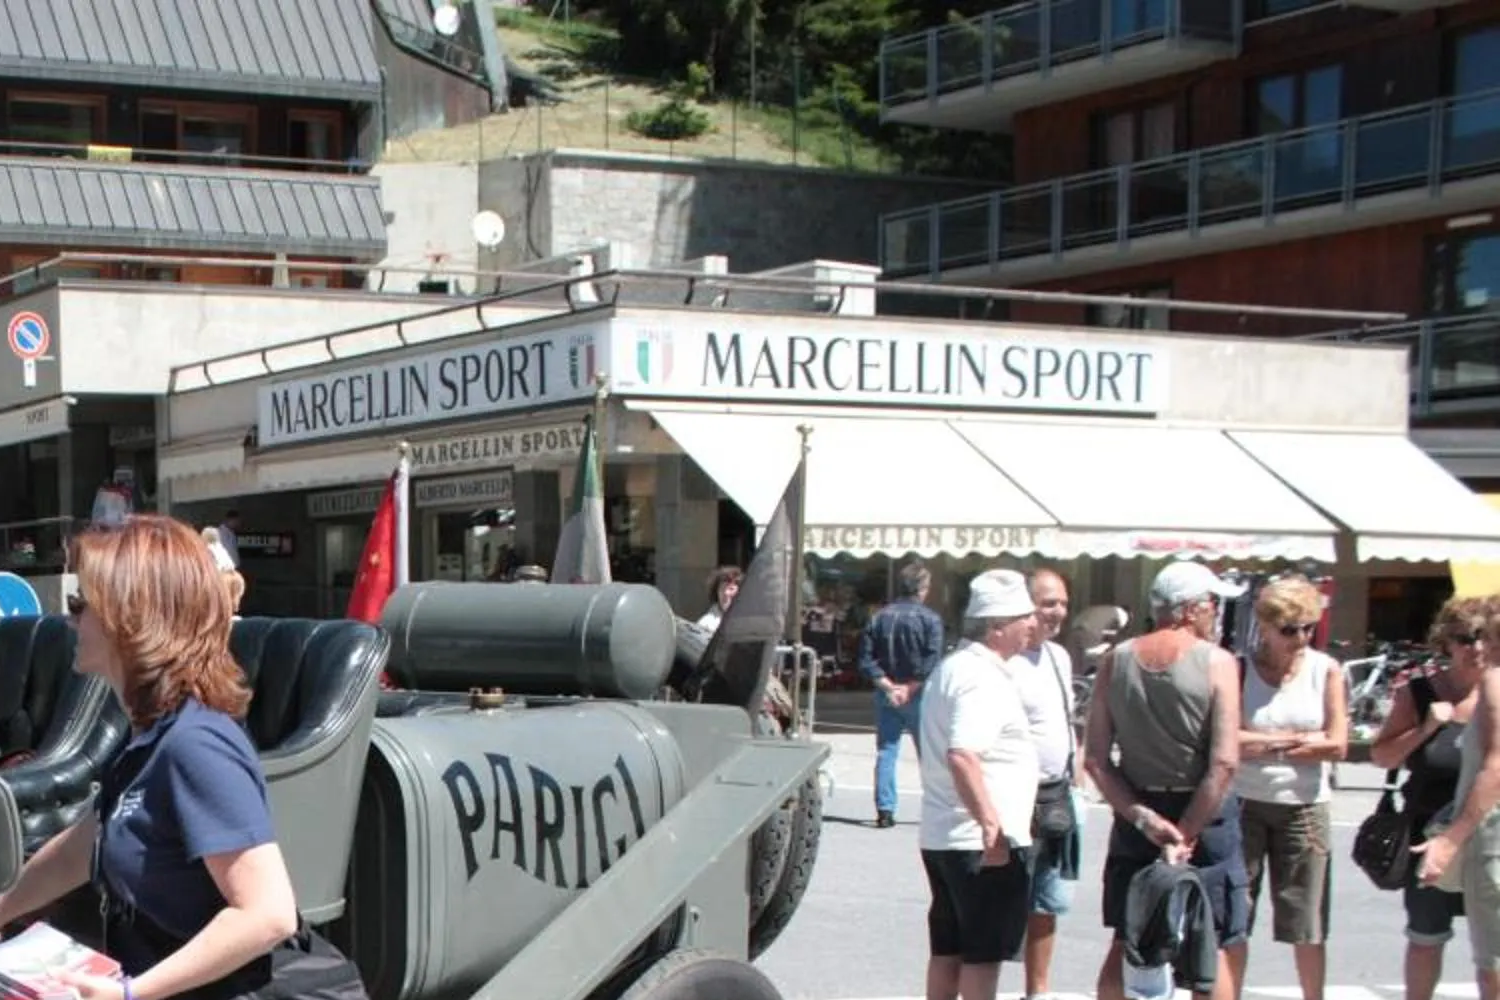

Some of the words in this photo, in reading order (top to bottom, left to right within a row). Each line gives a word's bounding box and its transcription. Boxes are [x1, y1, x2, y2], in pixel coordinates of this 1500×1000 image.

[270, 361, 429, 438] MARCELLIN
[439, 340, 554, 411] SPORT
[701, 332, 988, 396] MARCELLIN
[1000, 344, 1154, 404] SPORT
[411, 434, 515, 466] MARCELLIN
[520, 427, 587, 454] SPORT
[802, 526, 942, 549] ARCELLIN
[953, 526, 1040, 549] SPORT
